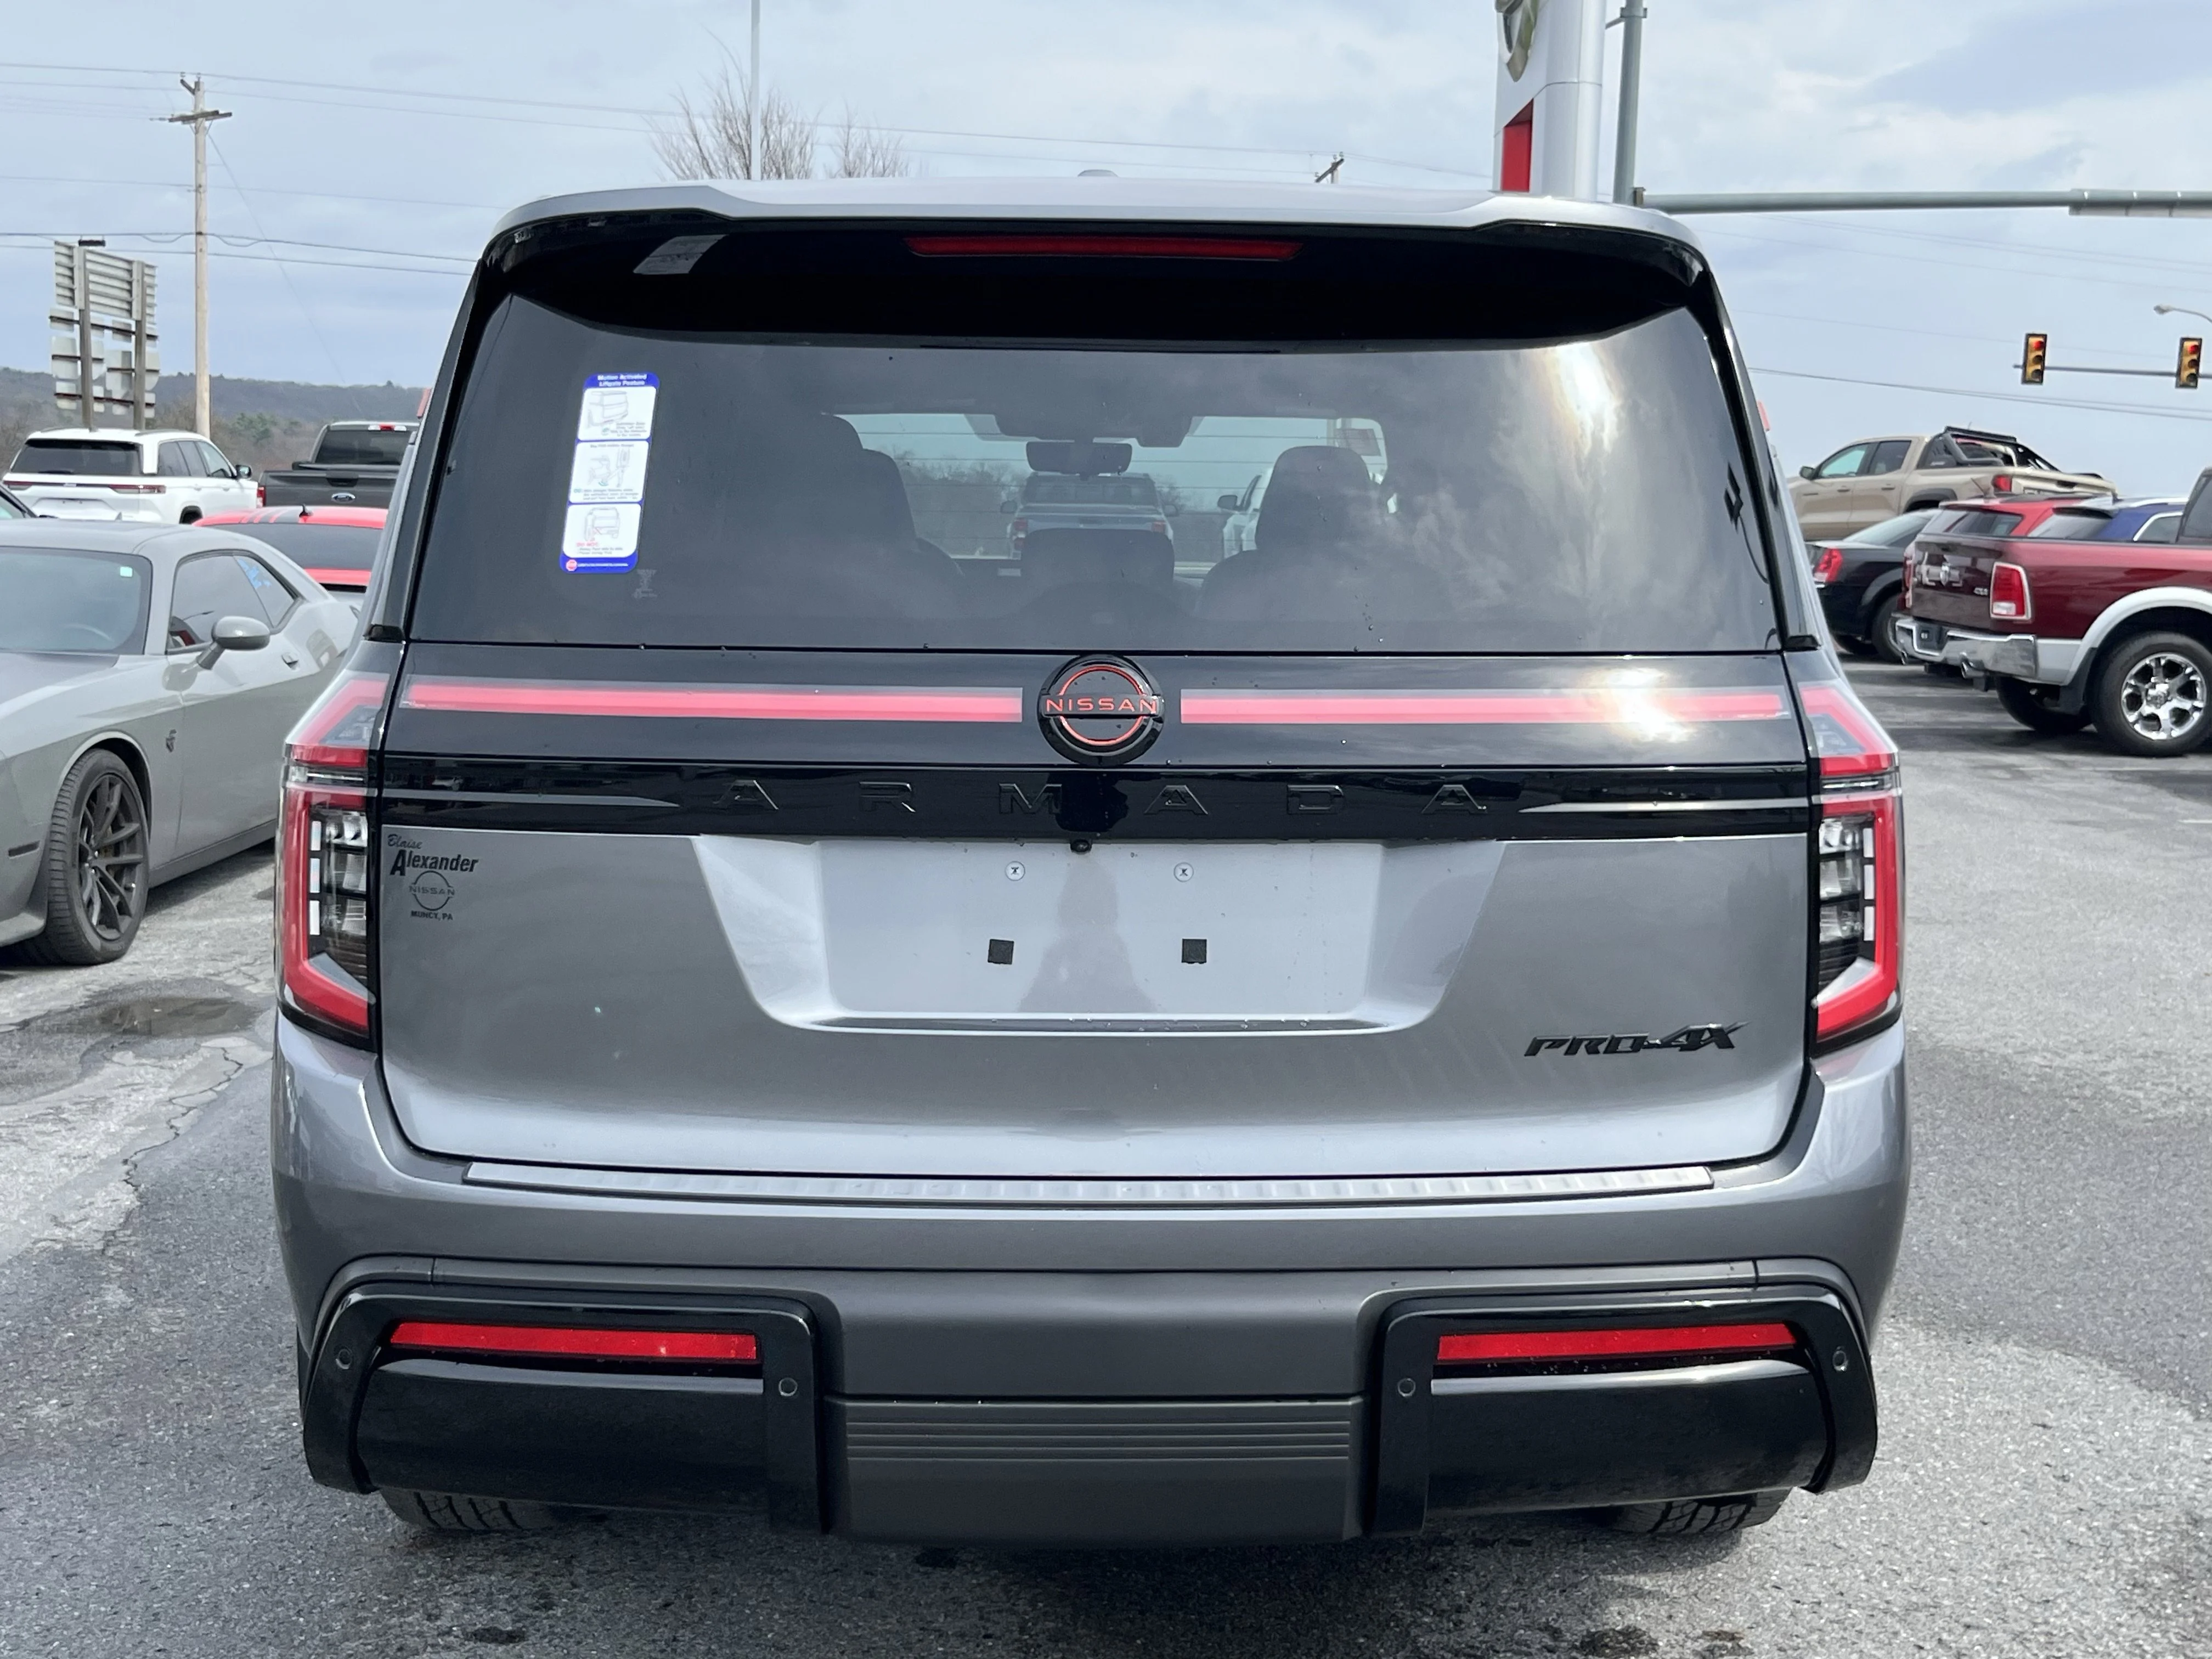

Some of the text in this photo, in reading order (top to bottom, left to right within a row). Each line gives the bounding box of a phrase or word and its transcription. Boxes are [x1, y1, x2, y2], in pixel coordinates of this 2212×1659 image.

[1046, 697, 1157, 714] NISSAN
[712, 780, 1488, 815] ARMADA
[387, 833, 423, 850] Blaise
[390, 849, 479, 876] Alexander
[408, 885, 455, 896] NISSAN
[410, 910, 441, 921] MUNCY,
[1524, 1021, 1751, 1057] PRO-4X
